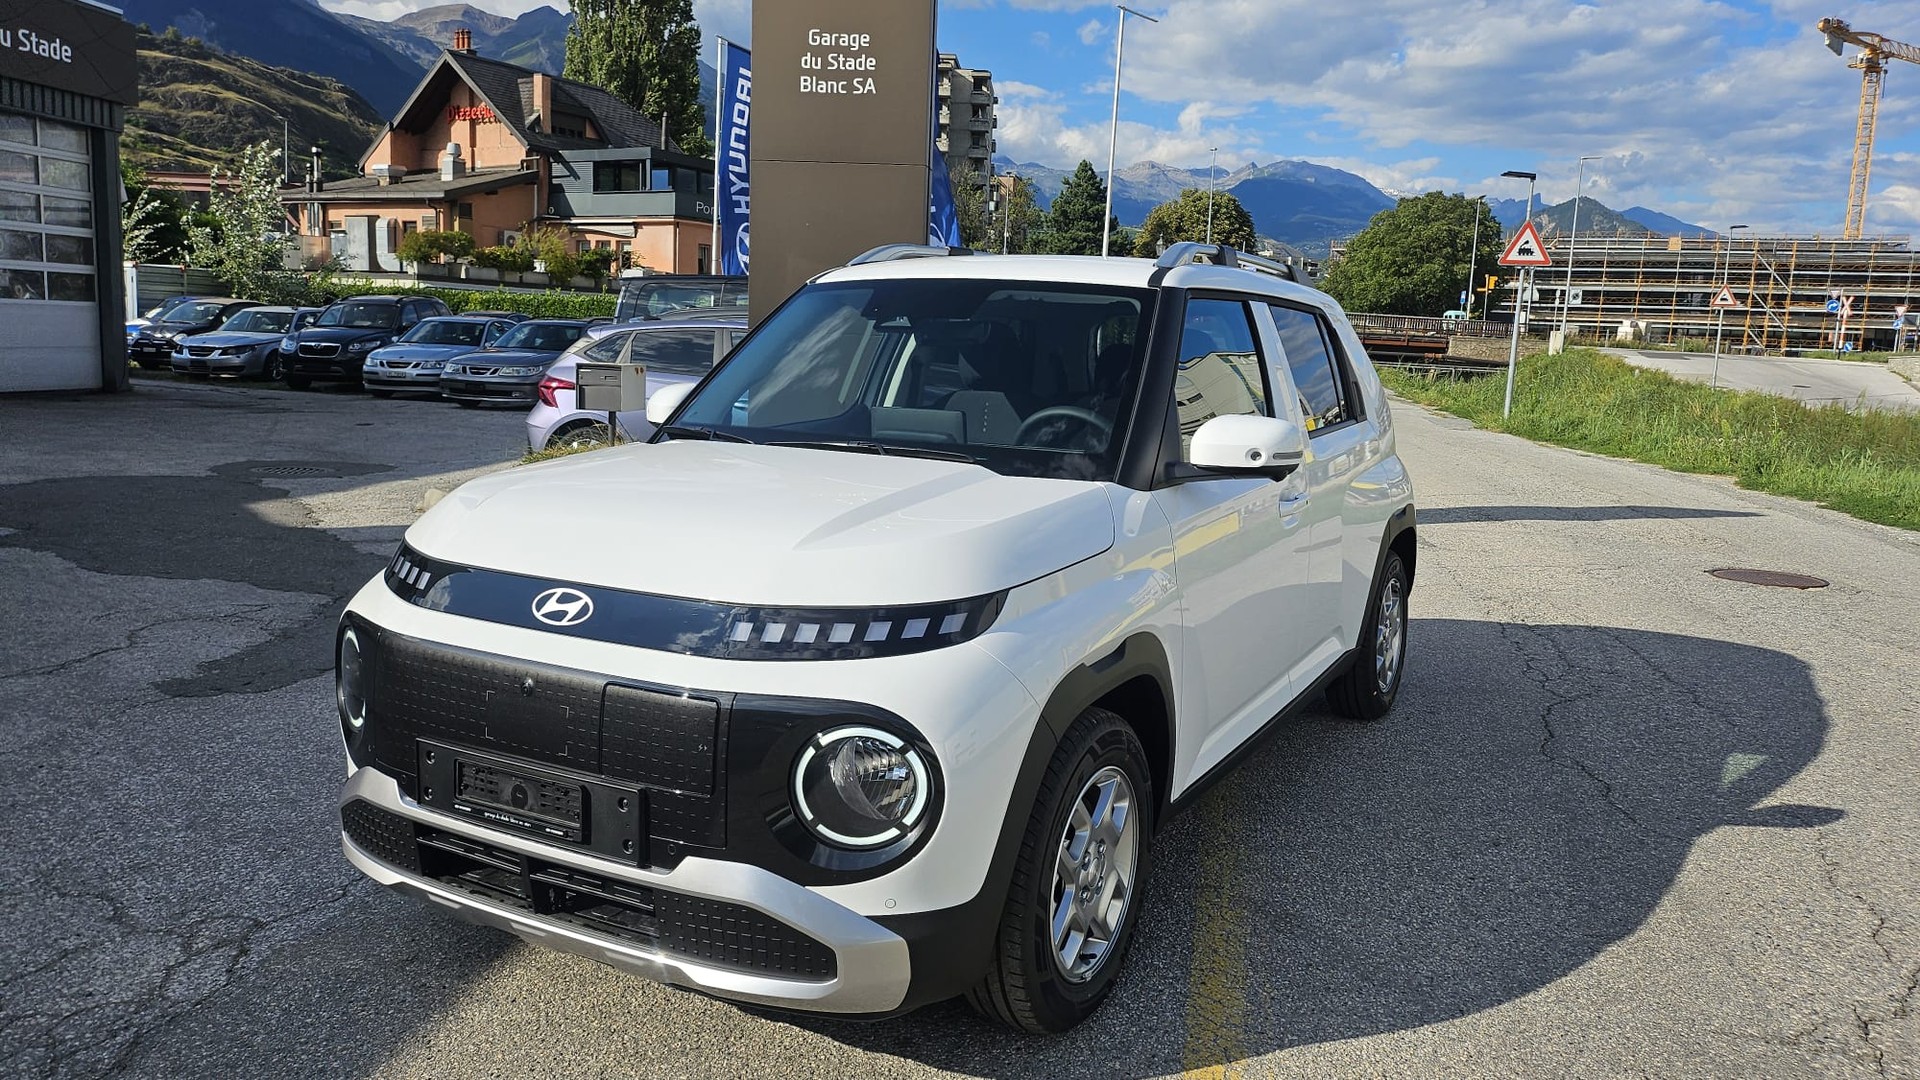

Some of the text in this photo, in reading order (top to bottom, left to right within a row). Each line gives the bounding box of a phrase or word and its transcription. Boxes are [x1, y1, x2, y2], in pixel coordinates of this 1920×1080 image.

[18, 28, 72, 63] Stade
[808, 29, 870, 51] Garage
[801, 52, 877, 71] du Stade
[800, 75, 877, 95] Blanc SA
[728, 66, 752, 214] HYUNDAI
